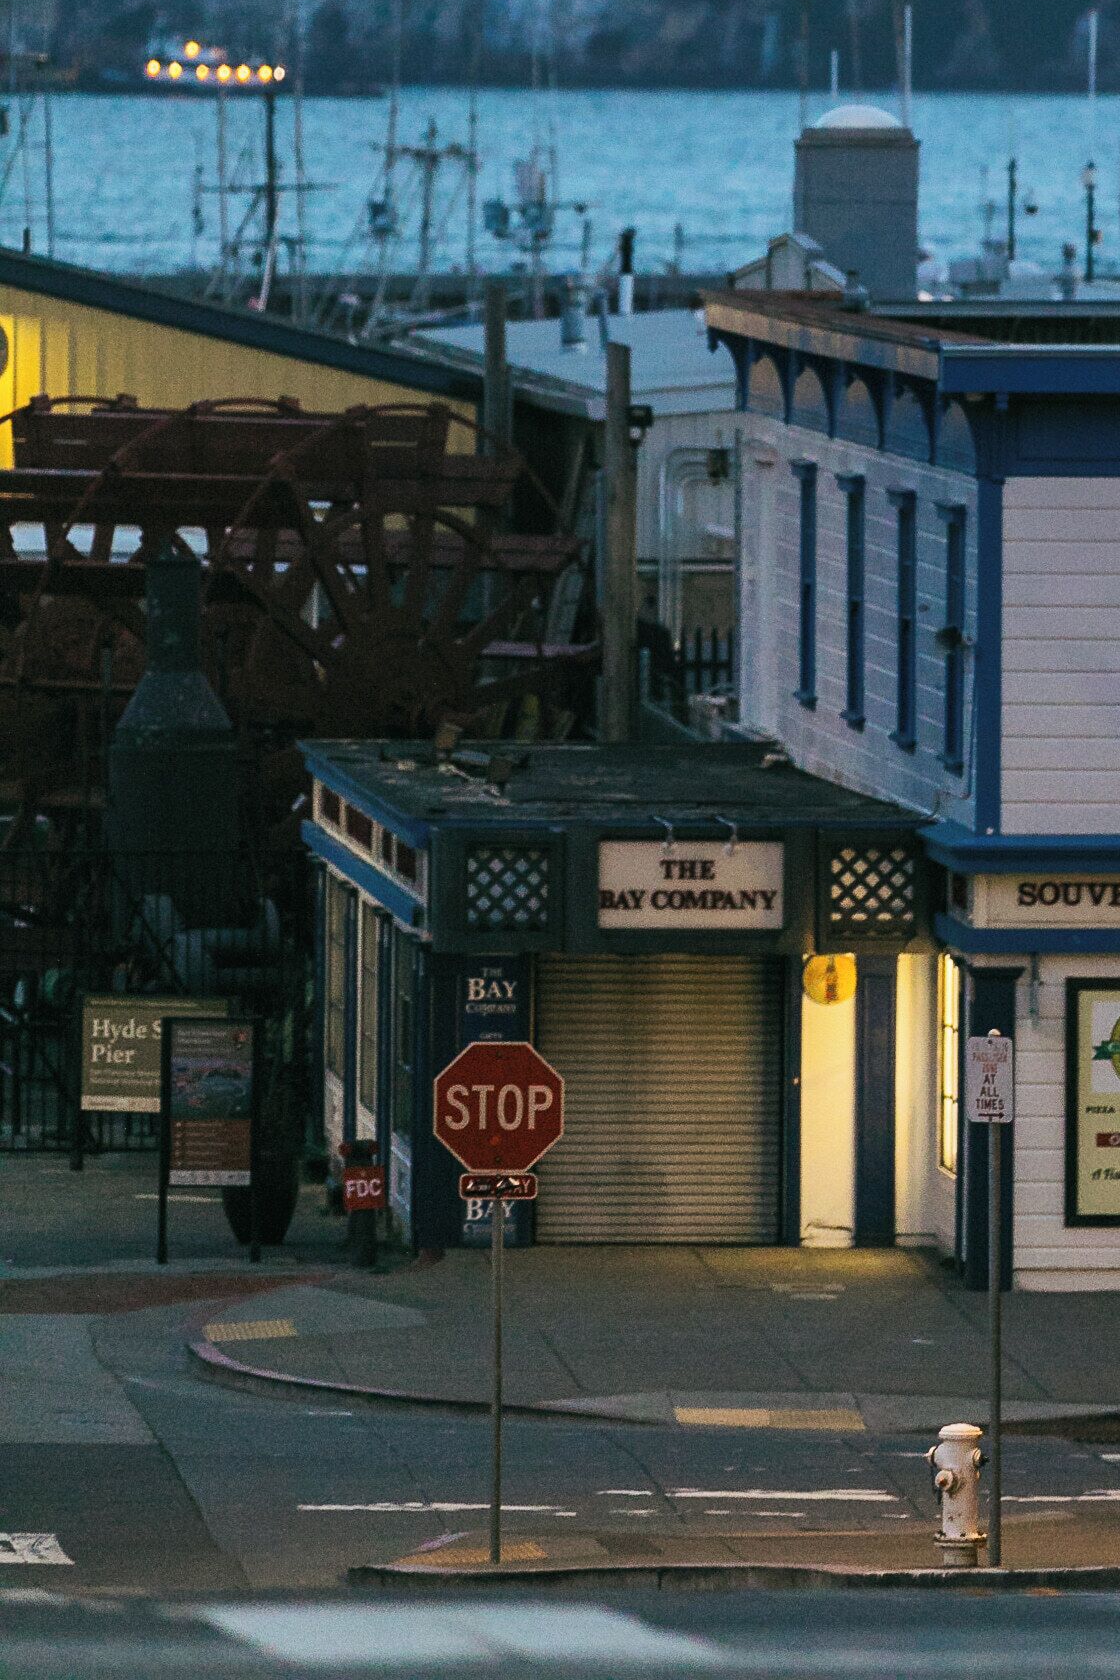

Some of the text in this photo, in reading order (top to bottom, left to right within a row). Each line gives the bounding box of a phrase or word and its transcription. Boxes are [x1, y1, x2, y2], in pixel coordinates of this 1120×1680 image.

[659, 858, 716, 881] THE
[600, 888, 778, 911] BAY COMPANY
[466, 977, 518, 1001] BAY
[92, 1018, 149, 1044] Hyde
[91, 1044, 136, 1064] Pier
[983, 1073, 996, 1085] AT
[980, 1085, 1000, 1098] ALL
[444, 1084, 553, 1131] STOP
[975, 1098, 1005, 1111] TIMES
[345, 1178, 382, 1199] FDC
